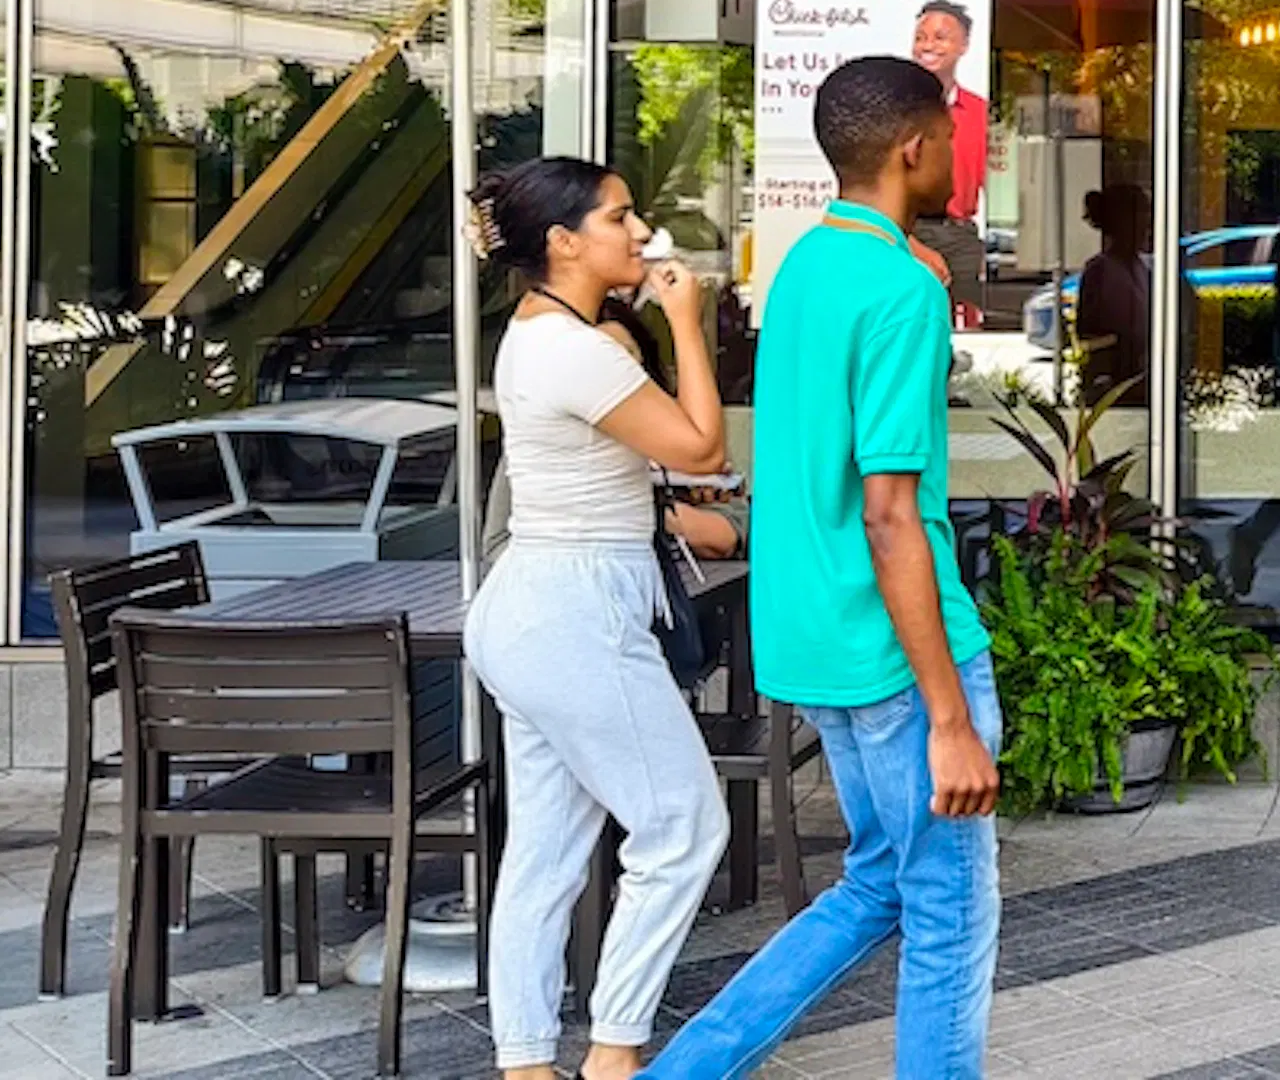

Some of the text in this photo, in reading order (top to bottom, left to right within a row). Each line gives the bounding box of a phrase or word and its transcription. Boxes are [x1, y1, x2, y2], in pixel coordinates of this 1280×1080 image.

[762, 52, 797, 71] Let
[803, 52, 830, 72] Us
[761, 78, 817, 98] In Yo
